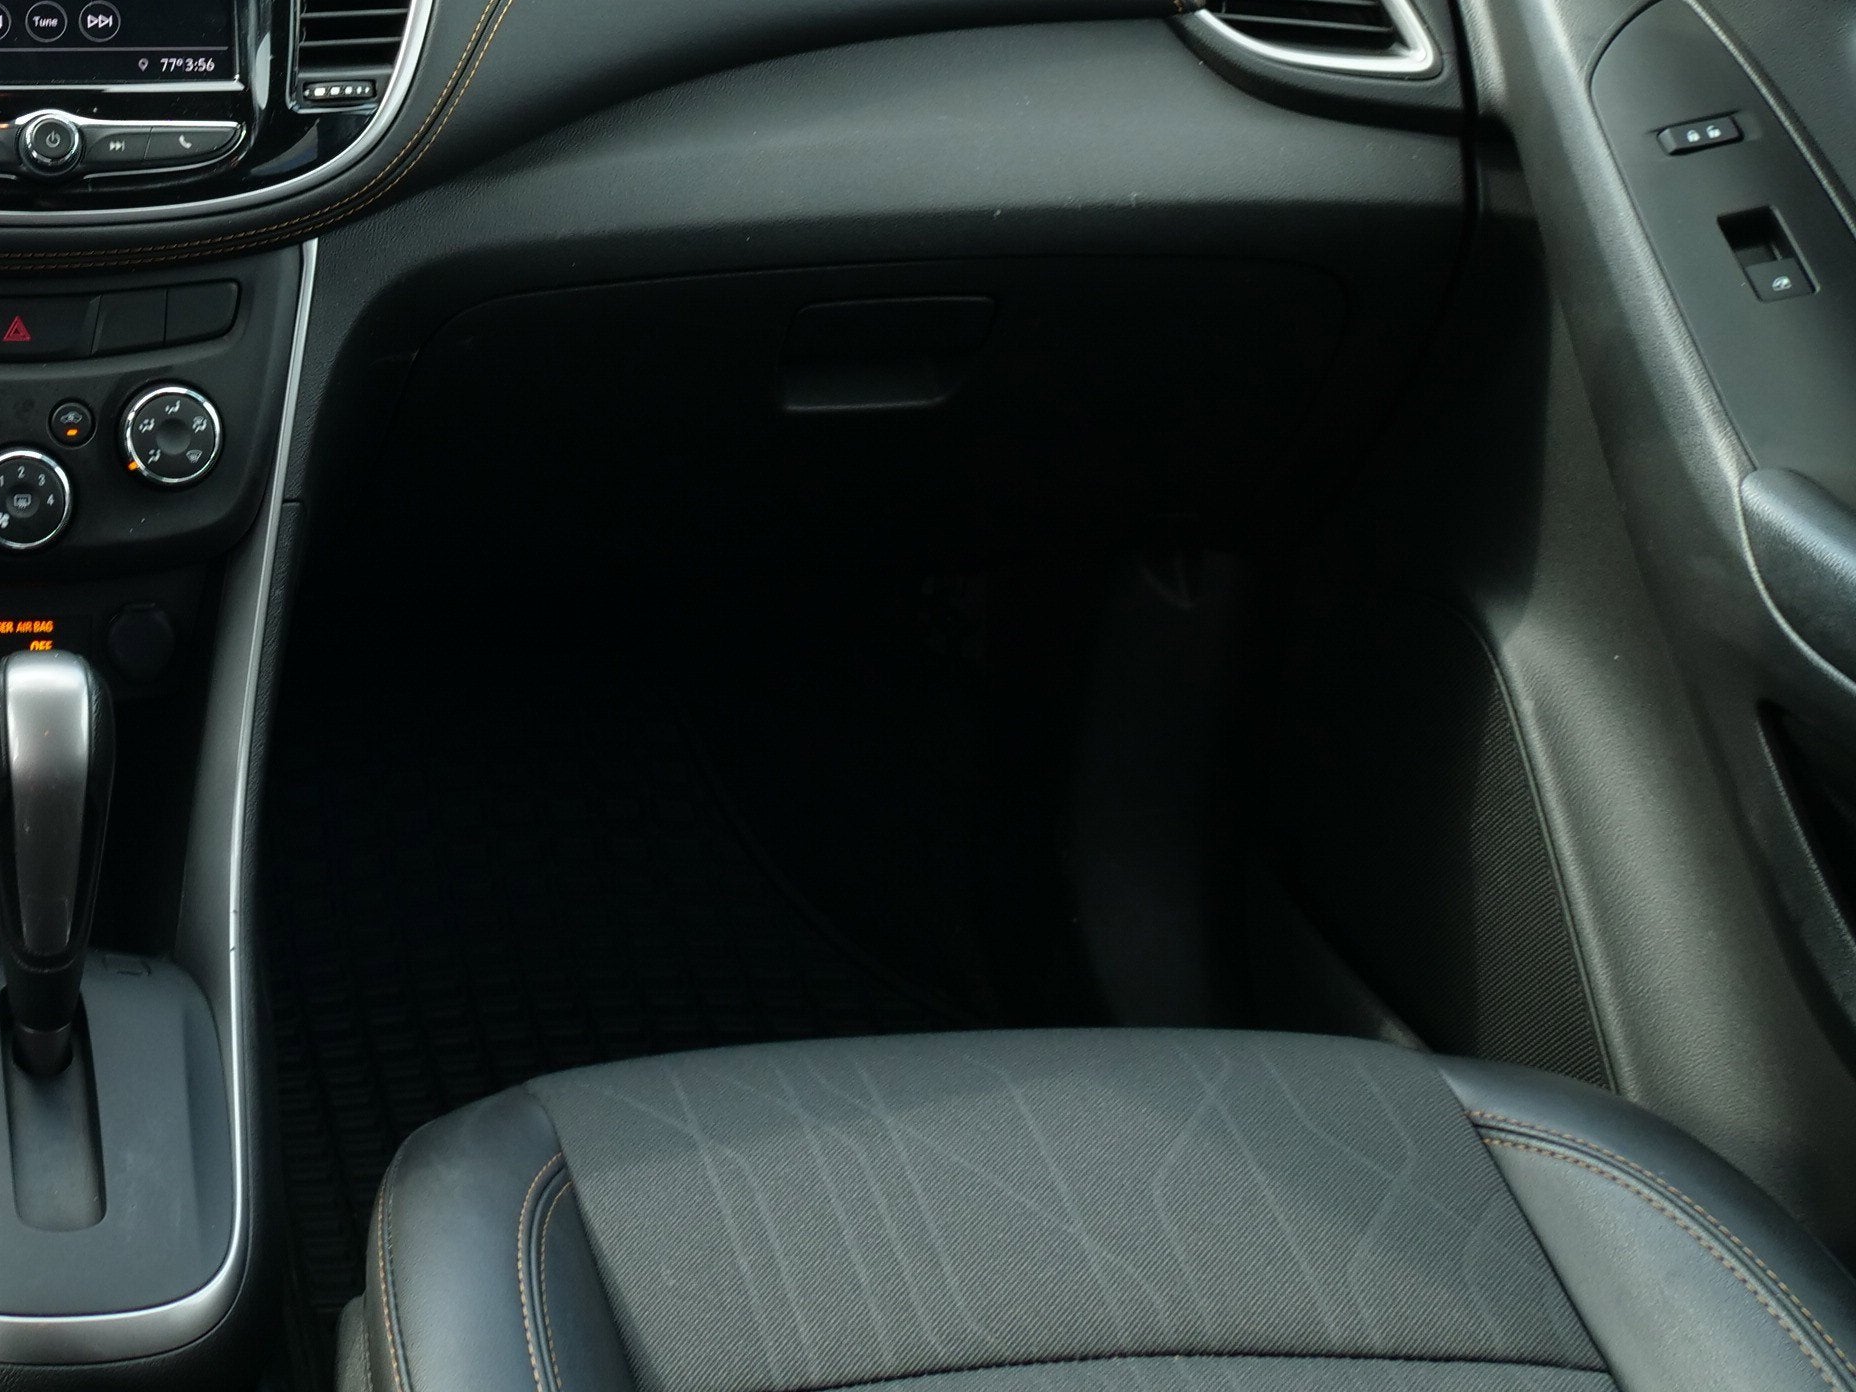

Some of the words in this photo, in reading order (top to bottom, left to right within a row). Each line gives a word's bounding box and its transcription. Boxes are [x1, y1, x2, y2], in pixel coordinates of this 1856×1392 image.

[32, 15, 59, 28] Tune
[185, 57, 215, 72] 3:56
[17, 465, 26, 479] 2
[16, 621, 33, 633] AIR
[33, 620, 54, 633] BAG
